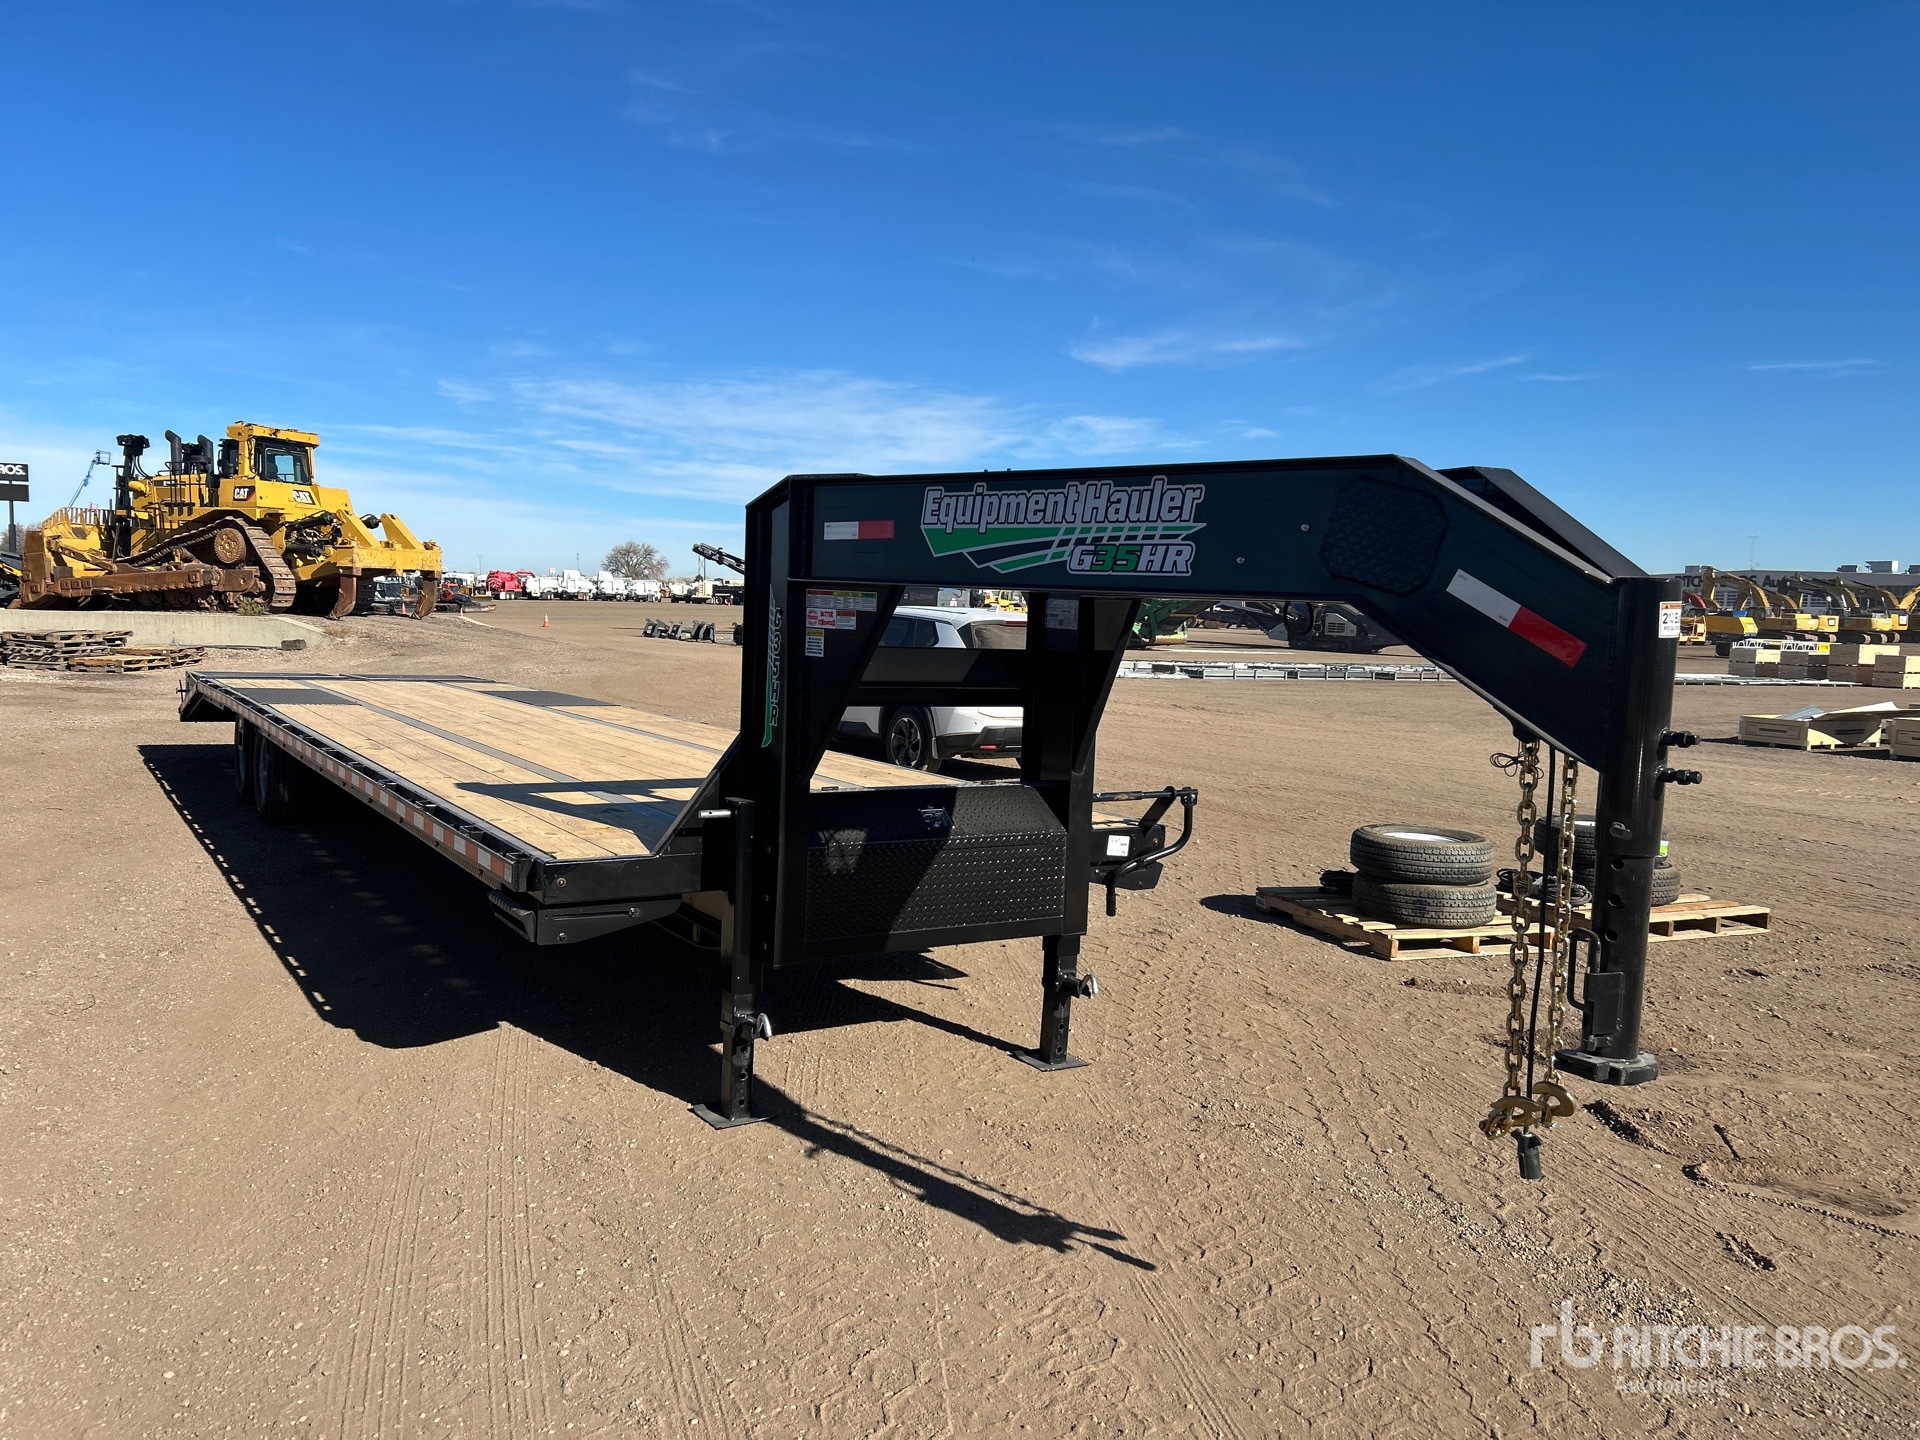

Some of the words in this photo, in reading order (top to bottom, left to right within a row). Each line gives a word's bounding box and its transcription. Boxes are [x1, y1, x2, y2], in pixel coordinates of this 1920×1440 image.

[234, 488, 249, 499] CAT
[292, 489, 313, 505] CAT
[1069, 543, 1194, 574] G35HR
[769, 607, 783, 726] G35HR
